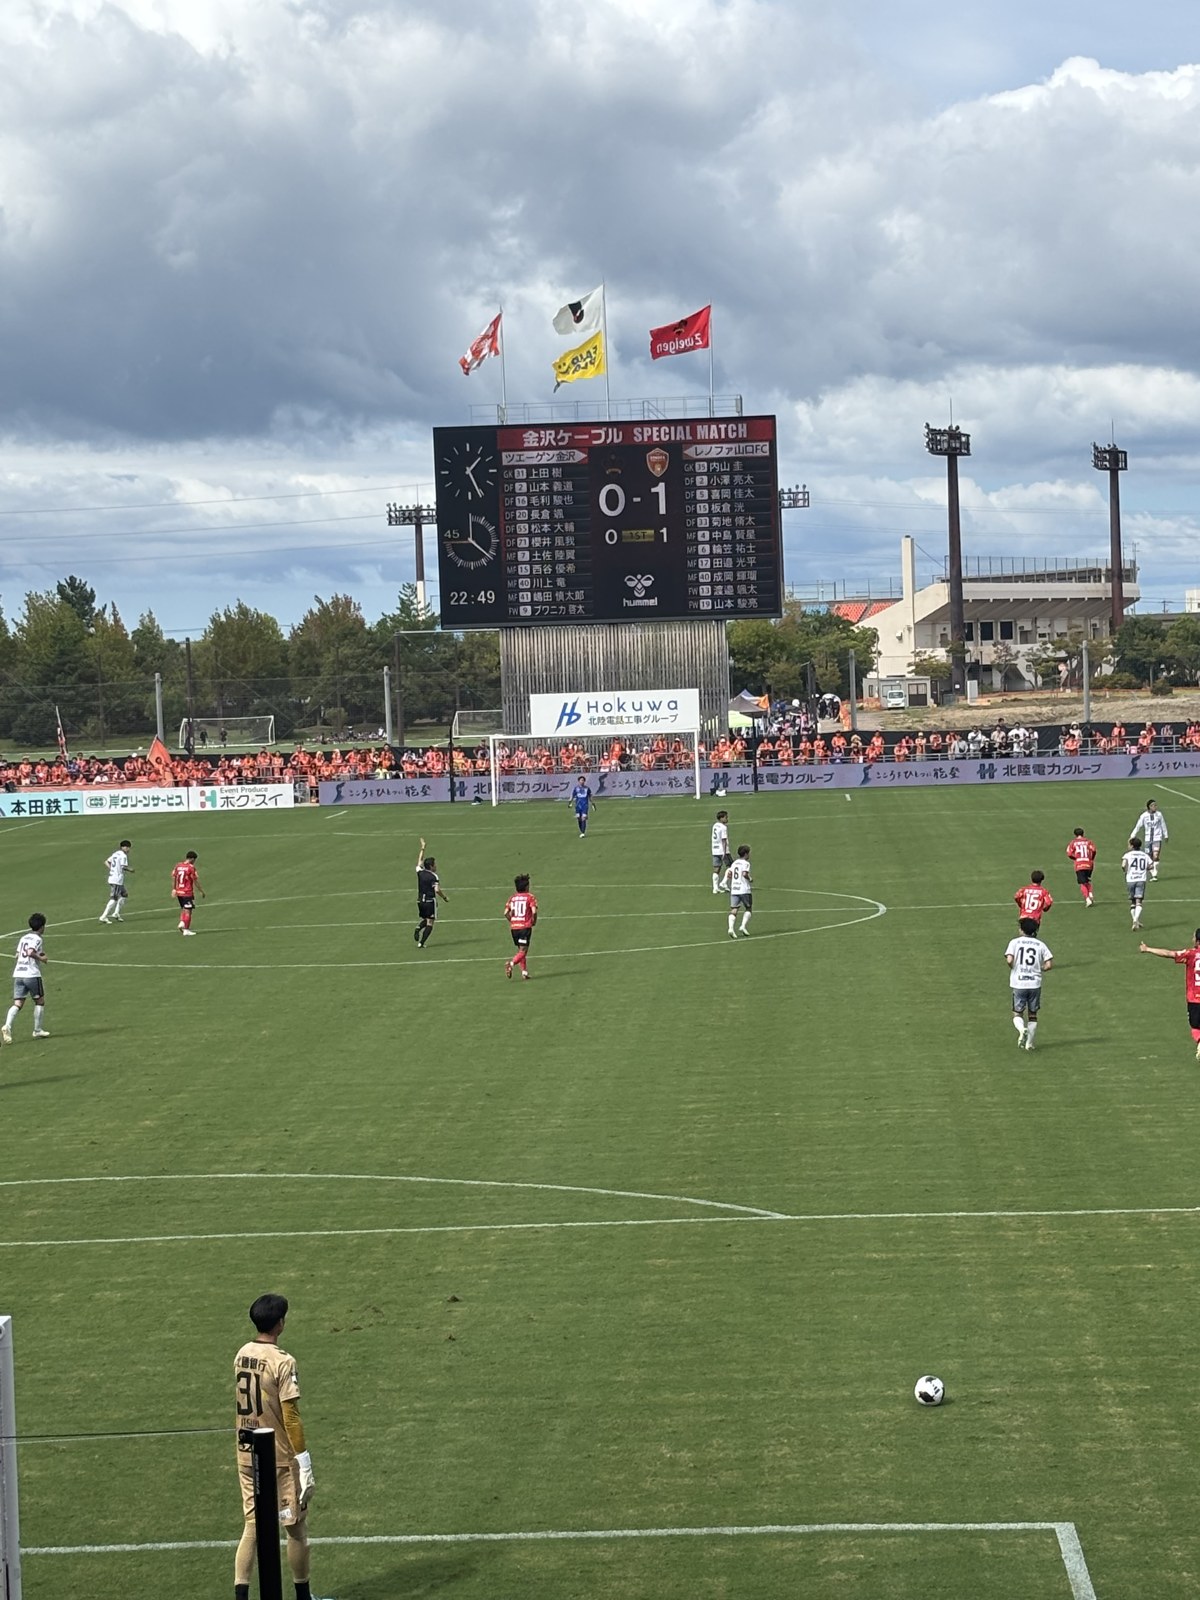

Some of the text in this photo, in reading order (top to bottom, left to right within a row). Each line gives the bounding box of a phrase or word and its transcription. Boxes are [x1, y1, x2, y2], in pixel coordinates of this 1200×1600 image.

[523, 423, 747, 447] 金沢ケーブル SPECIAL MATCH
[694, 444, 768, 456] レノファ山口FC
[505, 451, 576, 463] ツエーゲン金沢
[710, 461, 730, 472] 内山
[733, 461, 743, 471] 圭
[529, 468, 549, 478] 上田
[733, 475, 754, 485] 亮太
[504, 484, 513, 492] DF
[530, 482, 550, 492] 山本
[505, 498, 514, 506] DF
[530, 496, 550, 506] 毛利
[599, 484, 625, 516] 0
[651, 482, 666, 514] 1
[711, 503, 730, 513] 板倉
[531, 509, 550, 519] 長倉
[444, 530, 460, 538] 45
[531, 524, 551, 533] 松本
[605, 527, 667, 544] 0 1ST 1
[532, 551, 552, 560] 土佐
[687, 546, 696, 554] MF
[687, 560, 696, 568] MF
[736, 557, 756, 567] 光平
[532, 564, 552, 574] 西谷
[713, 572, 733, 581] 成岡
[507, 580, 517, 588] MF
[533, 578, 553, 588] 川上
[450, 590, 495, 605] 22:49
[623, 597, 657, 607] hummel
[714, 599, 734, 609] 山本
[587, 697, 678, 713] Hokuwa
[1003, 763, 1102, 776] 北陸電力グループ
[109, 793, 184, 809] 岸グリーンサービス
[11, 798, 79, 816] 本田鉄工
[1075, 845, 1088, 858] 41
[1131, 858, 1145, 871] 40
[179, 870, 185, 885] 7
[734, 867, 738, 879] 6
[1025, 894, 1039, 911] 16
[1019, 947, 1036, 966] 13
[236, 1371, 263, 1417] 31
